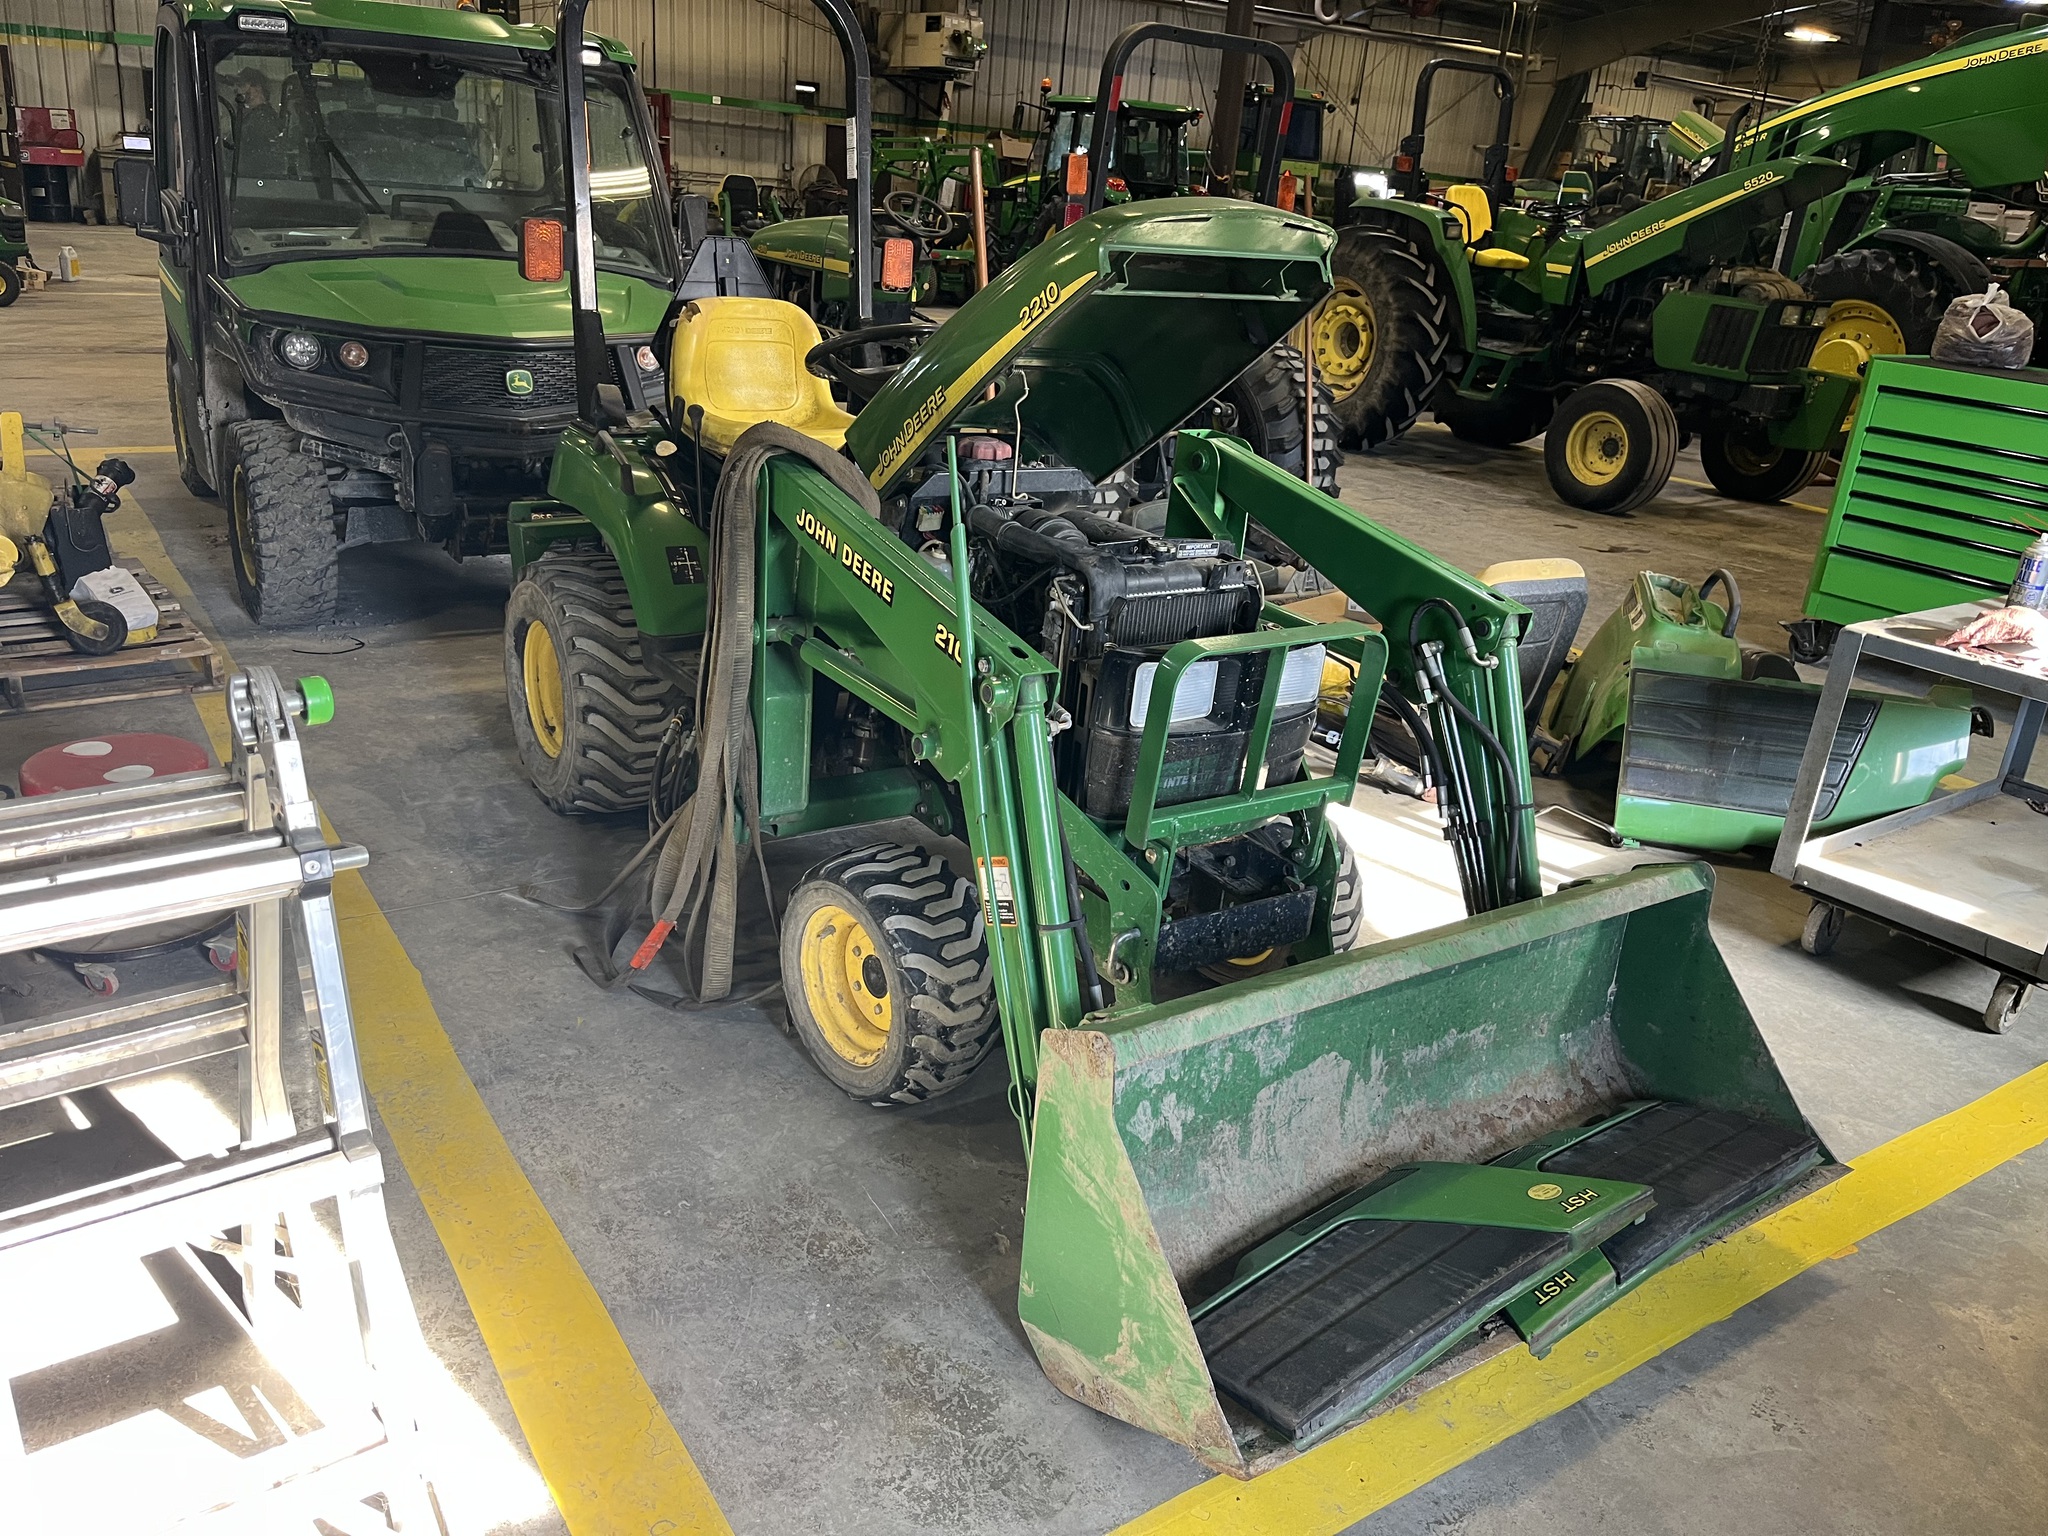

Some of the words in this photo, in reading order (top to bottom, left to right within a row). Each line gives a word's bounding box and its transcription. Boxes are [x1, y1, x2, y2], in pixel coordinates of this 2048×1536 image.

[1963, 52, 1998, 70] JOHN
[1998, 43, 2043, 60] DEERE
[1743, 171, 1774, 192] 5520
[1603, 238, 1632, 257] JOHN
[1631, 219, 1666, 241] DEERE
[800, 250, 821, 264] DEERE
[1019, 281, 1060, 331] 2210
[877, 429, 906, 477] JOHN
[904, 386, 946, 442] DEERE
[796, 508, 838, 560] JOHN
[841, 541, 895, 608] DEERE
[2021, 556, 2044, 573] FREE
[1558, 1187, 1600, 1214] HST
[1534, 1270, 1577, 1306] HST
